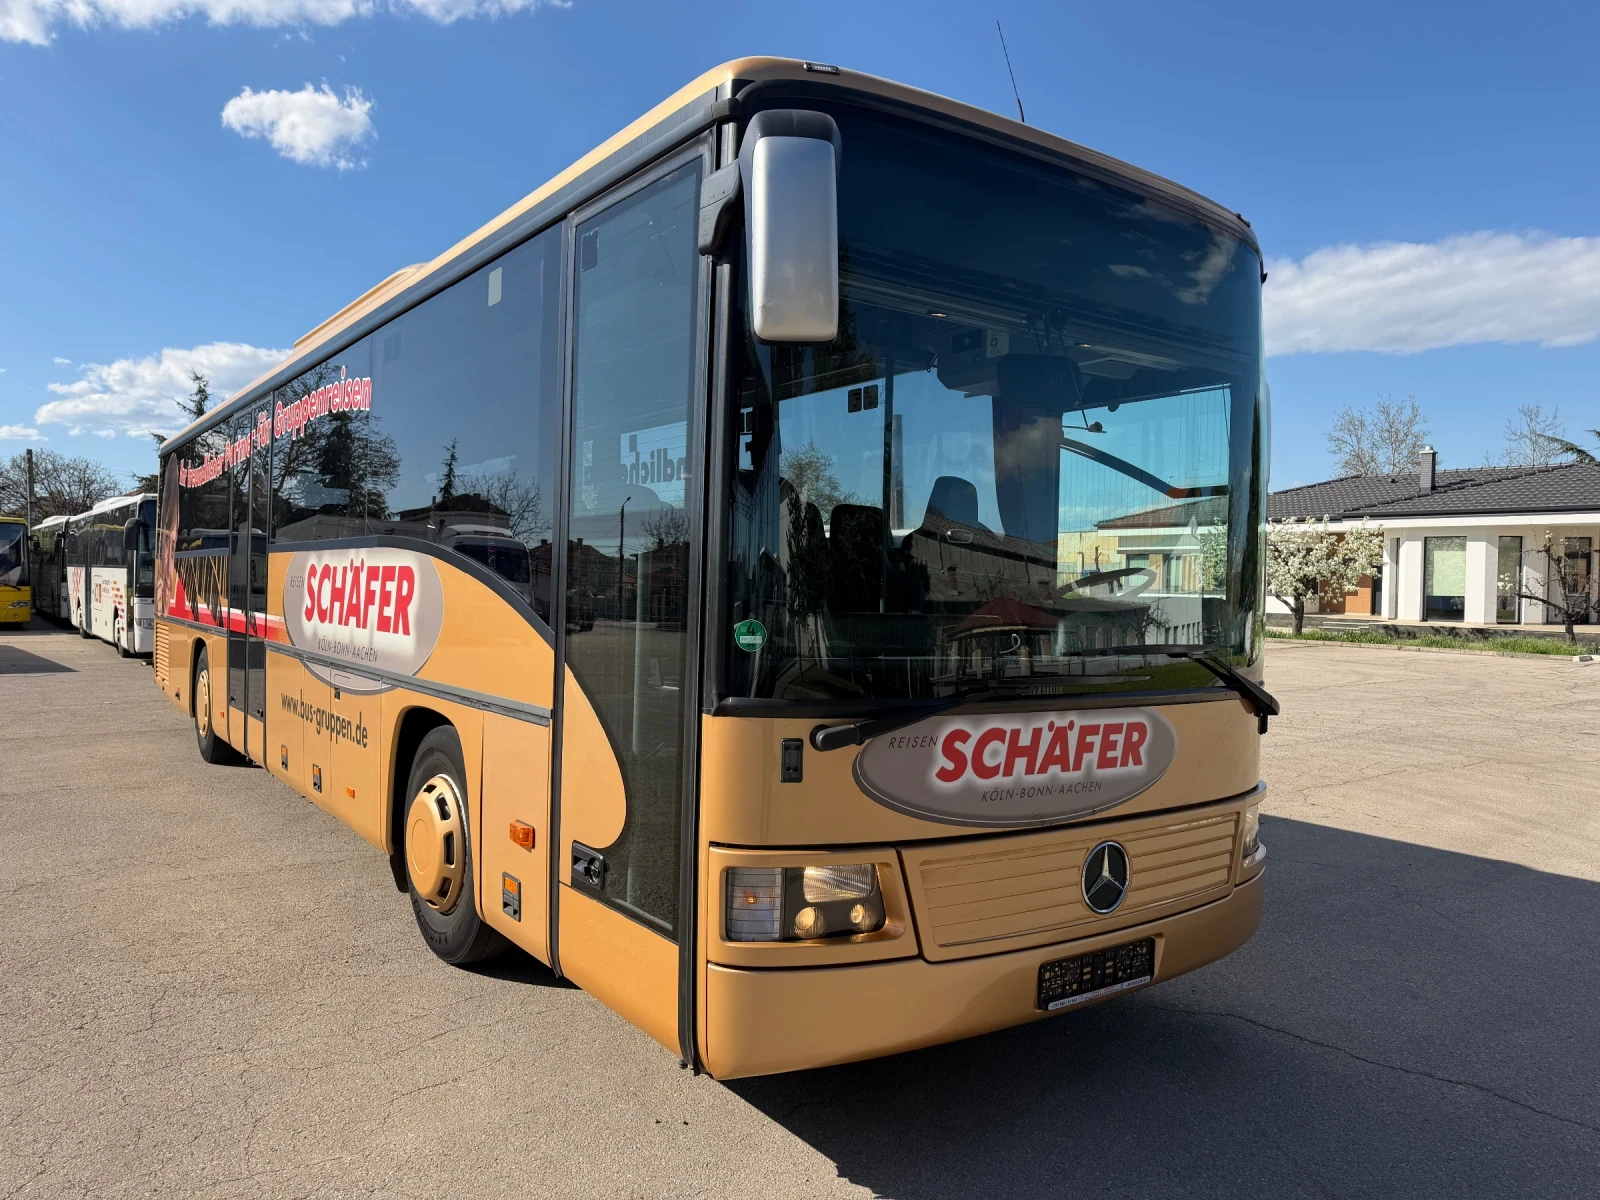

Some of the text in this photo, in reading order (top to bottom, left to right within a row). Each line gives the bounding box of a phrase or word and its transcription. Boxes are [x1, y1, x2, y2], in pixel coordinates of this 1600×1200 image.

[257, 409, 271, 449] für
[273, 365, 372, 440] Gruppenreisen
[290, 575, 305, 589] REISEN
[304, 557, 416, 636] SCHÄFER
[746, 621, 756, 636] 4
[318, 635, 378, 663] KÖLN-BONN-AACHEN
[281, 689, 368, 749] www.bus-gruppen.de
[888, 735, 939, 749] REISEN
[934, 719, 1148, 783] SCHÄFER
[980, 780, 1103, 802] KÖLN-BONN-AACHEN
